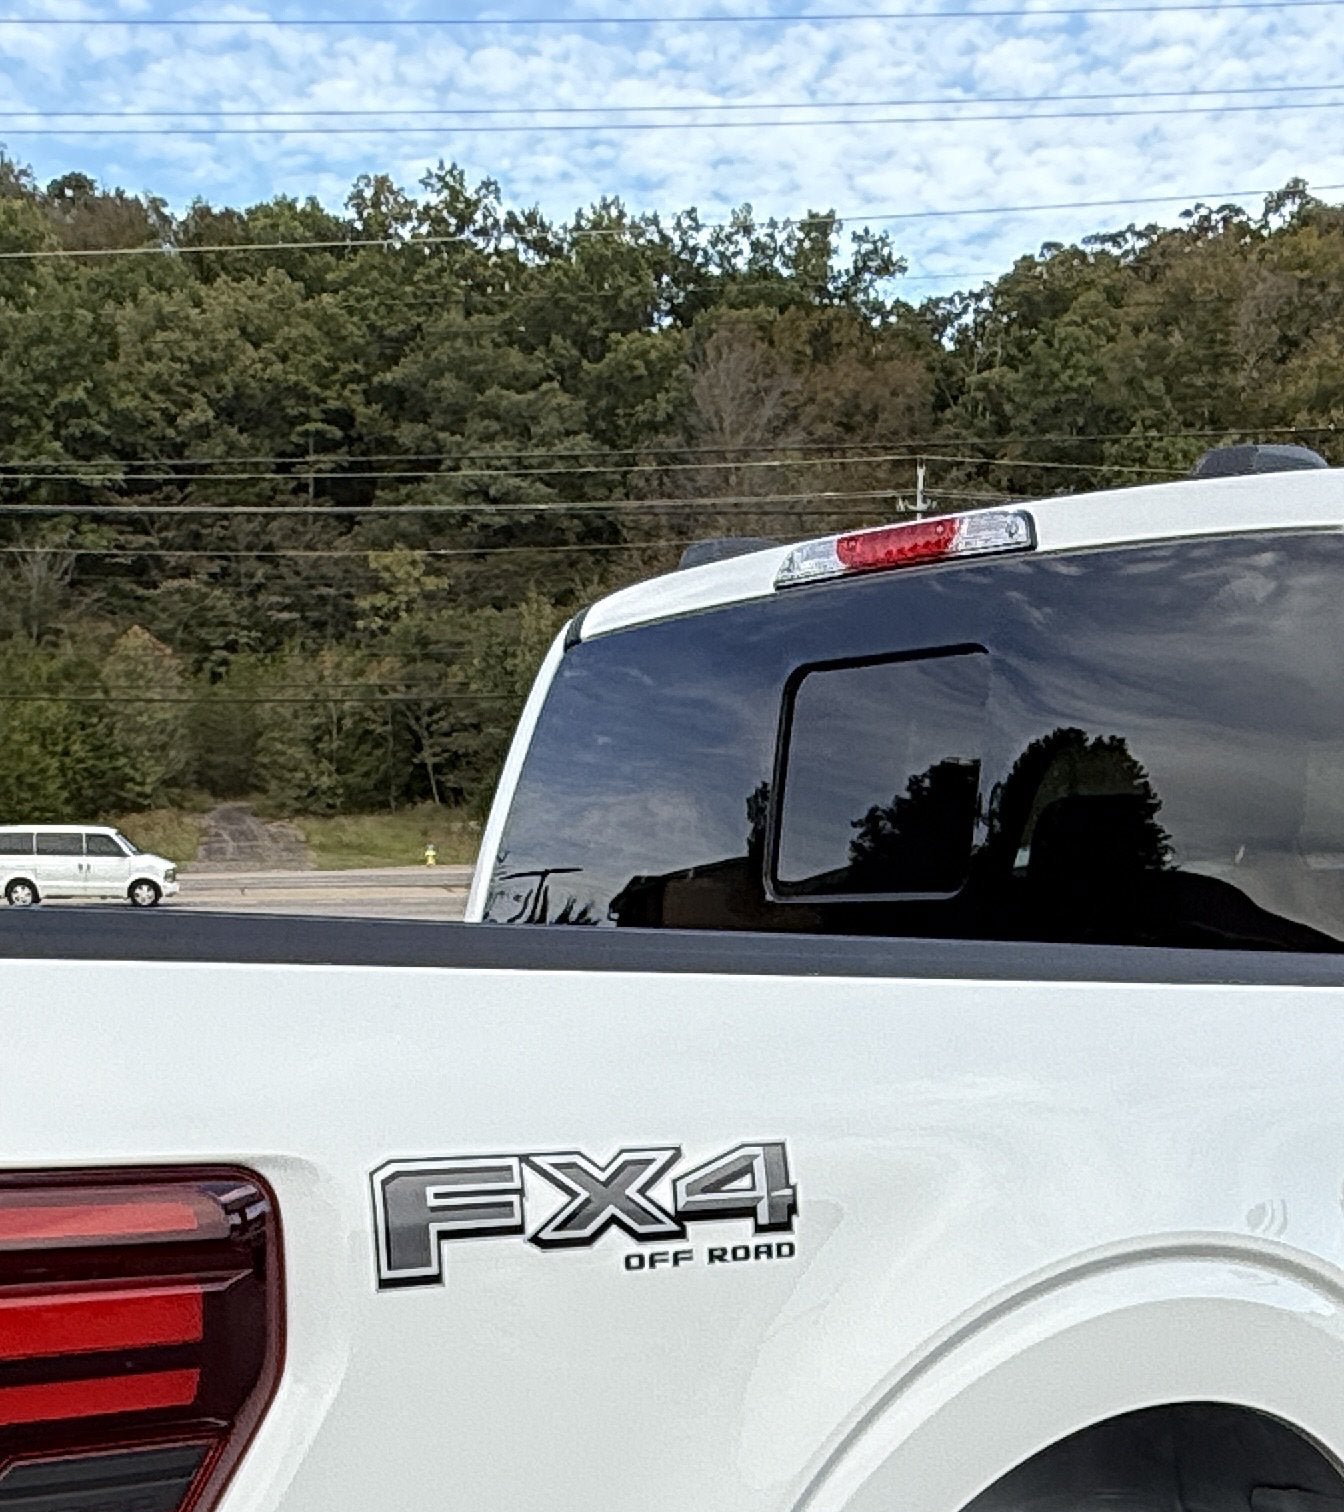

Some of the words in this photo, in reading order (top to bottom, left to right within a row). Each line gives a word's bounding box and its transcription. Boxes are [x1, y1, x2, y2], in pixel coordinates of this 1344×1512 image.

[369, 1141, 798, 1292] FX4
[624, 1248, 694, 1271] OFF
[707, 1242, 796, 1264] ROAD
